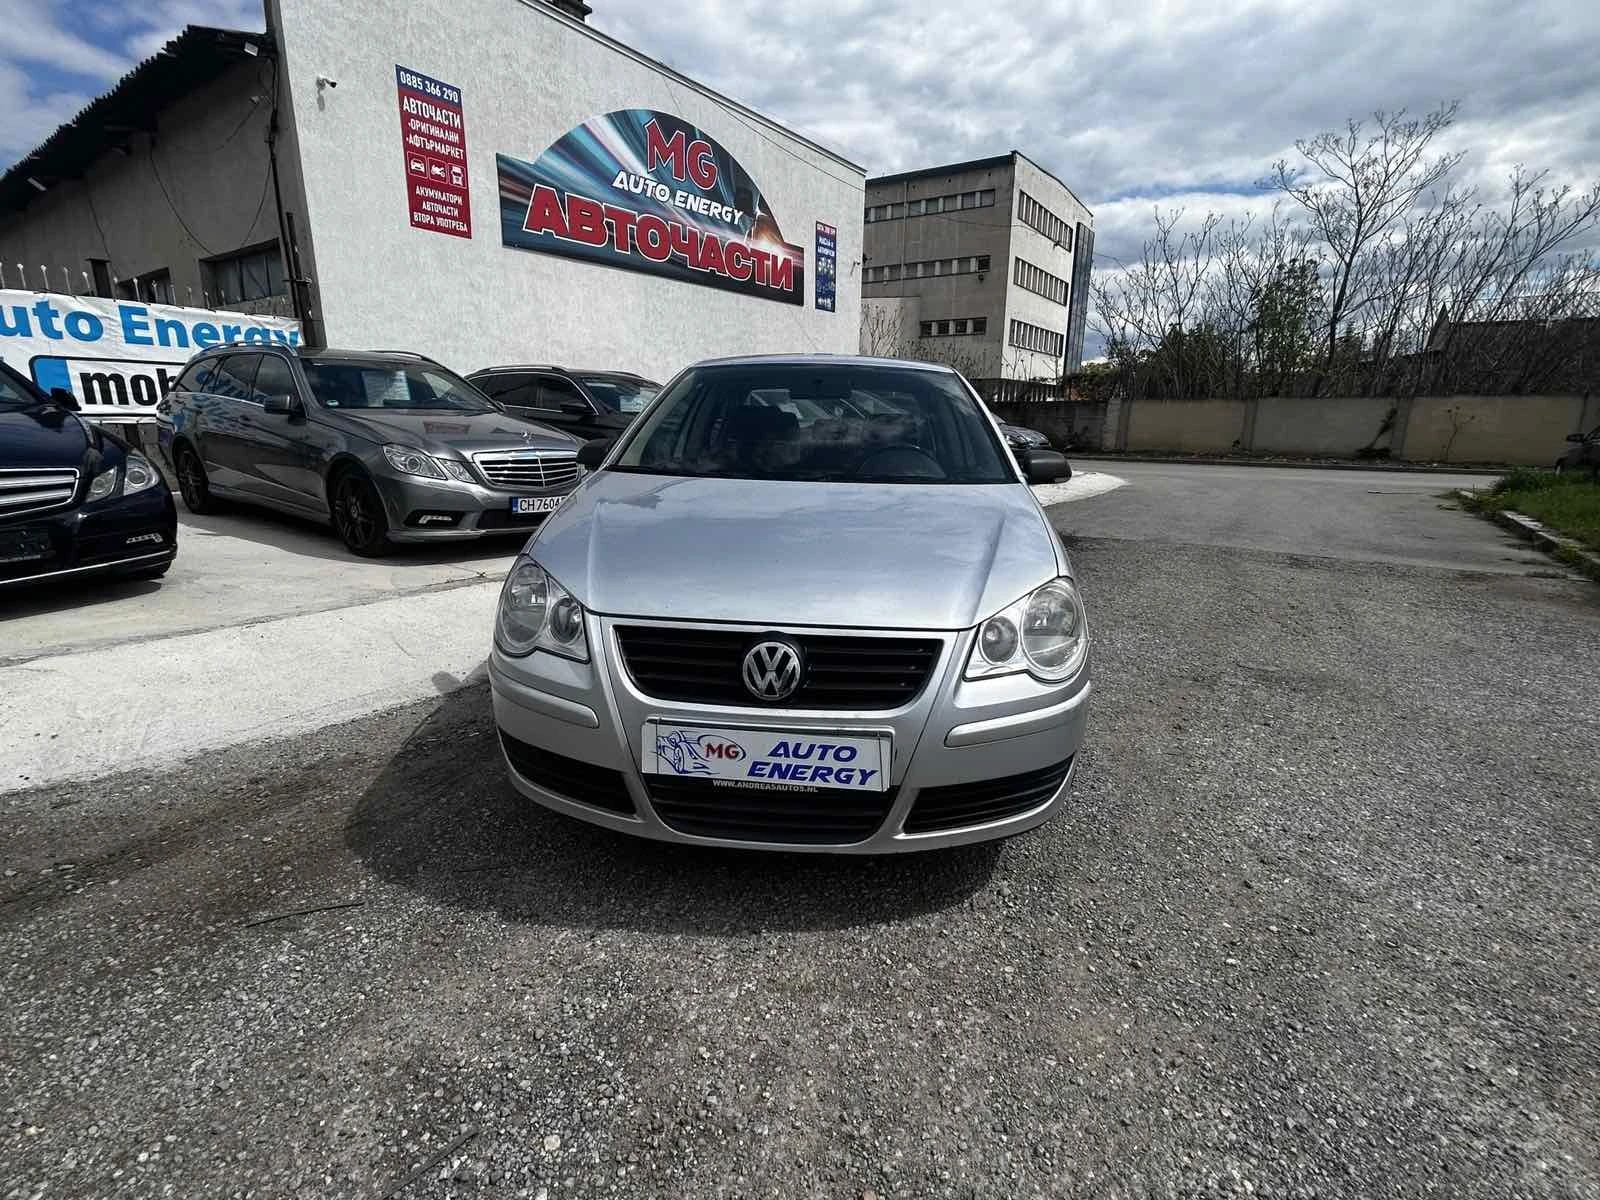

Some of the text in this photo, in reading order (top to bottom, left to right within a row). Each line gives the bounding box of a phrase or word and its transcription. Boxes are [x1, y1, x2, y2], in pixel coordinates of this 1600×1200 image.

[400, 71, 459, 103] 0885 366 290
[403, 95, 461, 129] АВТОЧАСТИ
[644, 118, 718, 190] MG
[415, 185, 463, 206] АКУМУЛАТОРИ
[612, 170, 744, 225] AUTO ENERGY
[413, 211, 468, 233] ВТОРА УПОТРЕБА
[422, 201, 459, 218] АВТОЧАСТИ
[523, 183, 794, 292] АВТОЧАСТИ
[520, 497, 567, 512] CH 7604
[704, 742, 879, 786] MG ENERGY
[767, 740, 858, 763] AUTO
[712, 779, 819, 793] WWW.ANDREASAUTOS.NL
